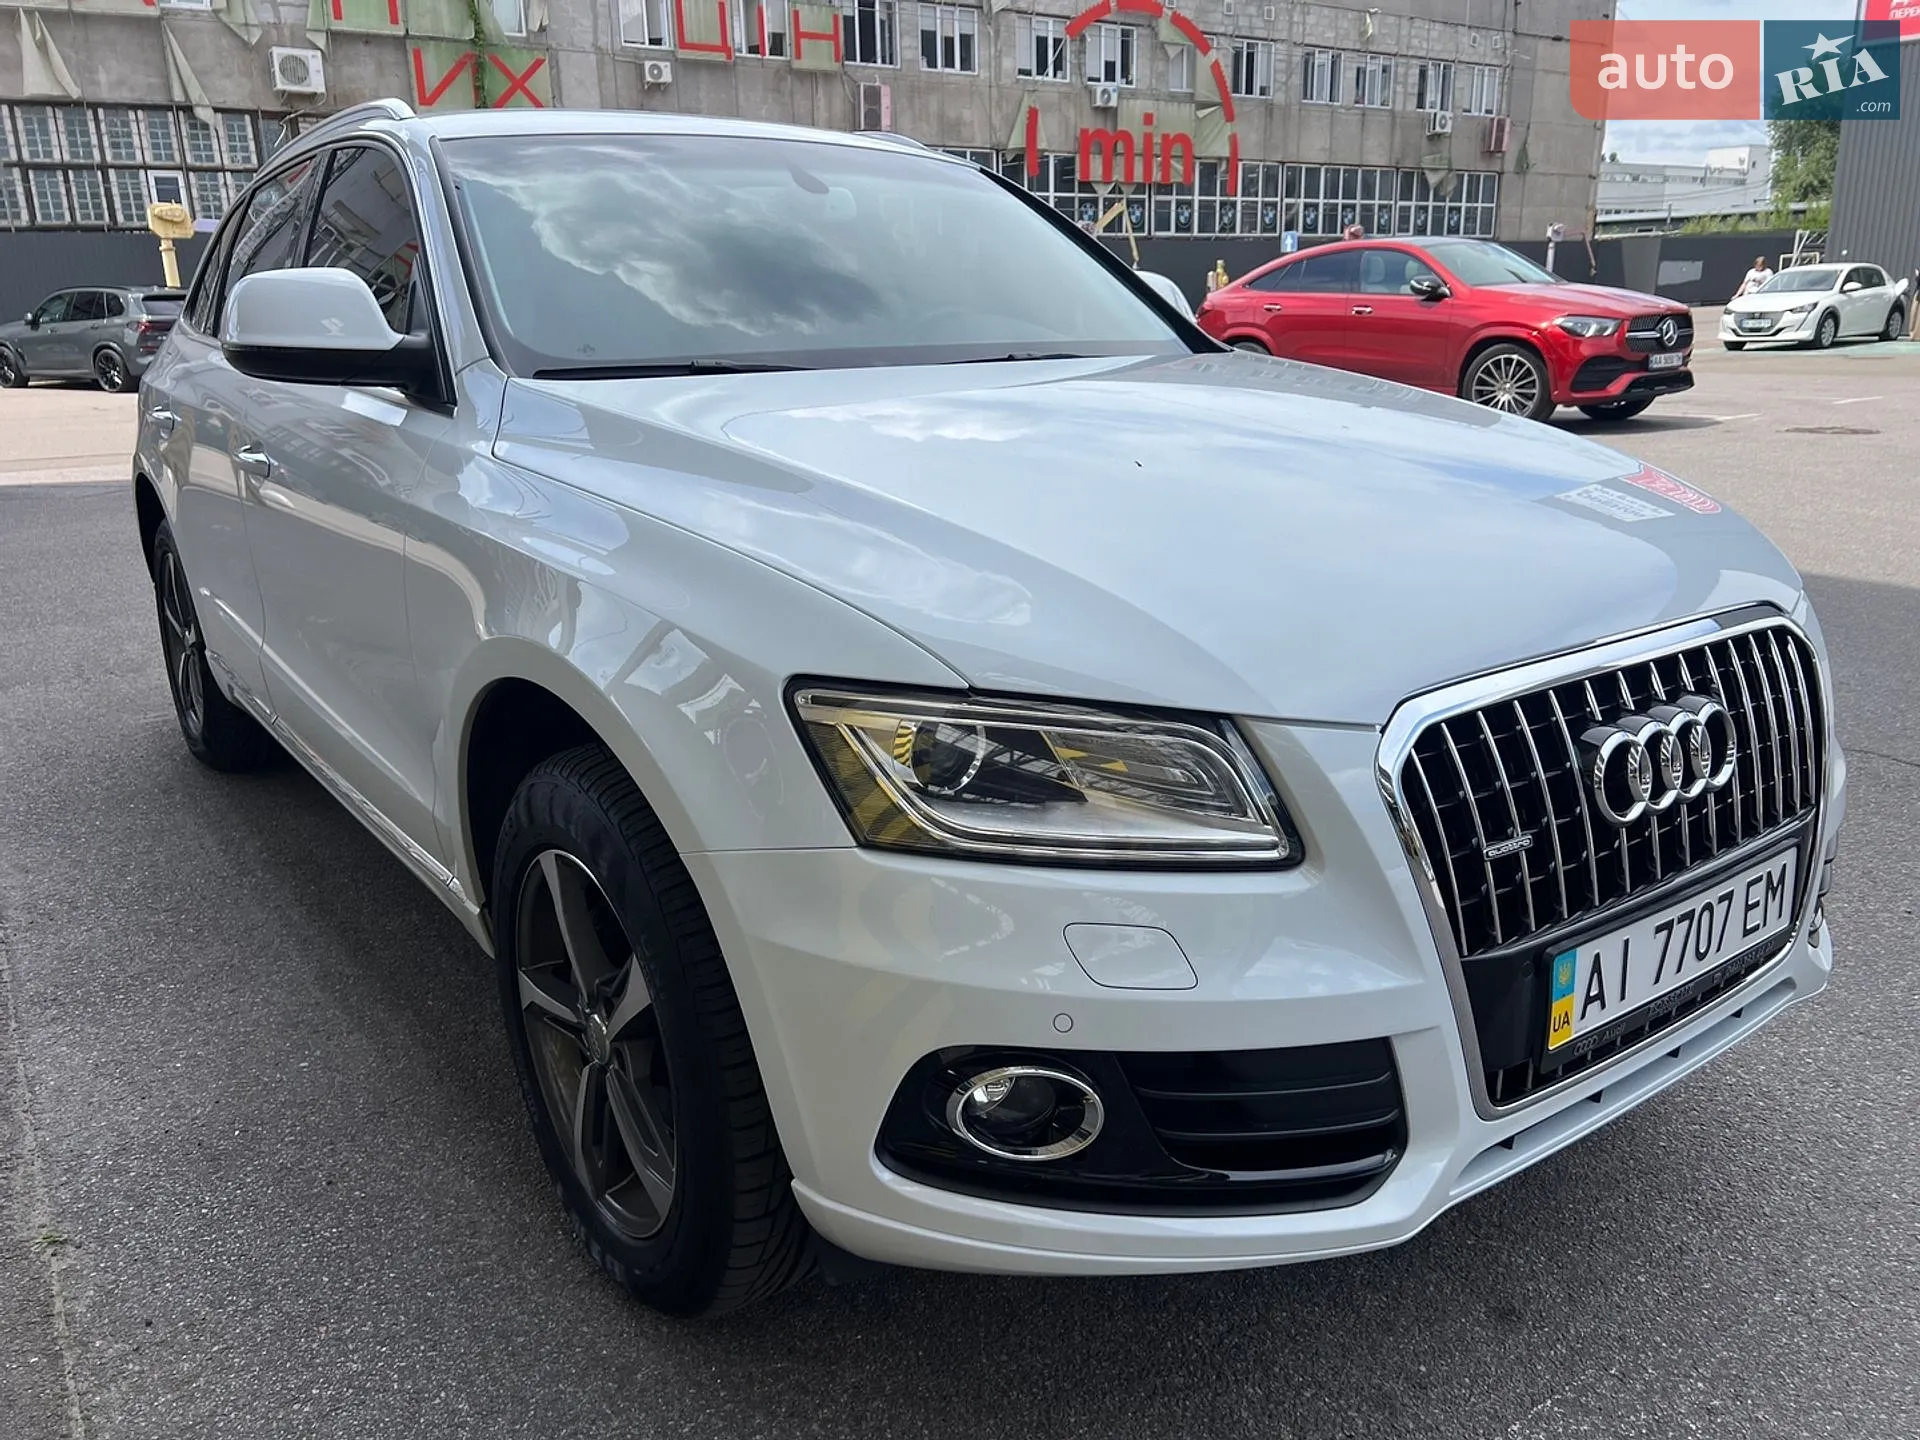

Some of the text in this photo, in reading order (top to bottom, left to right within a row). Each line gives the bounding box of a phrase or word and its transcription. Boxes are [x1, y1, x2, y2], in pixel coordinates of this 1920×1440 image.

[1889, 6, 1920, 20] ПЕРЕ
[1079, 112, 1193, 185] min
[1488, 839, 1530, 857] quattro
[1580, 938, 1630, 1020] AI
[1653, 889, 1734, 985] 7707
[1742, 862, 1787, 938] EM
[1553, 1010, 1570, 1033] UA
